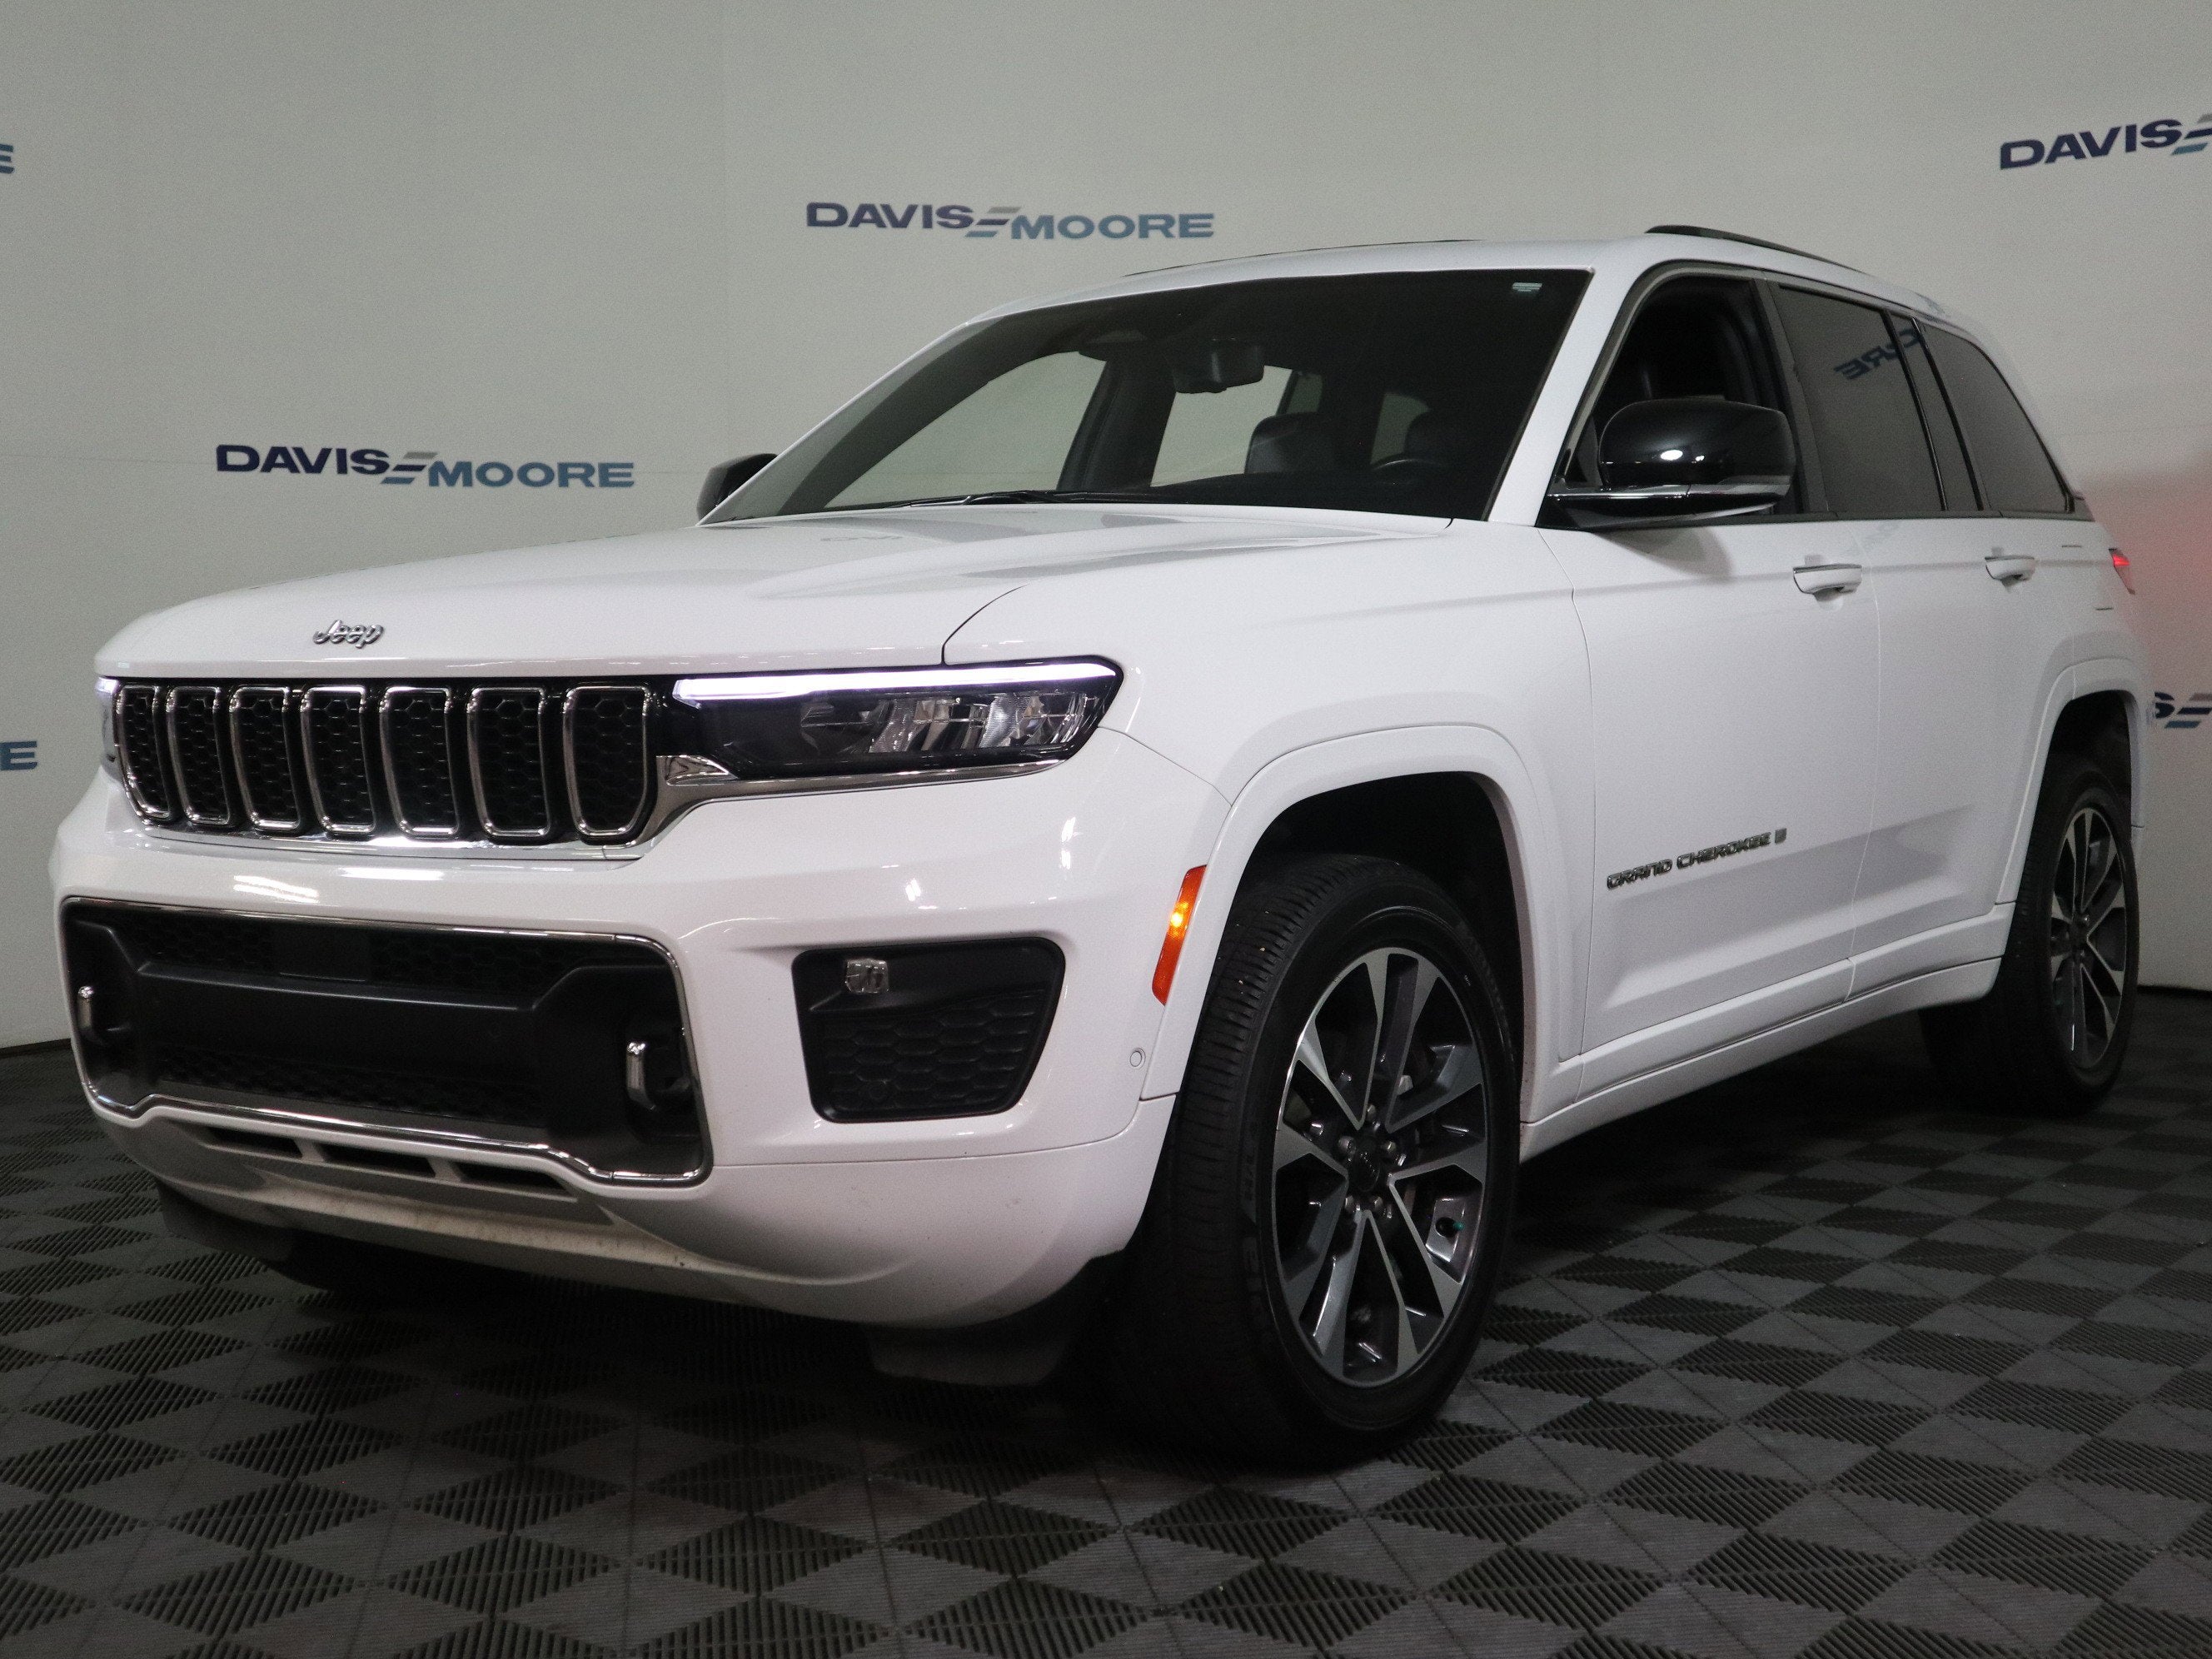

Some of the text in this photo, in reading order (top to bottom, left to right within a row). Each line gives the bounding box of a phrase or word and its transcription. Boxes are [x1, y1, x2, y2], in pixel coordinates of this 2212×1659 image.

[2000, 118, 2184, 170] DAVIS
[806, 202, 1215, 240] DAVIS MOORE
[216, 444, 635, 489] DAVIS MOORE
[312, 620, 385, 649] Jeep
[1607, 831, 1771, 890] GRAND CHEROKEE
